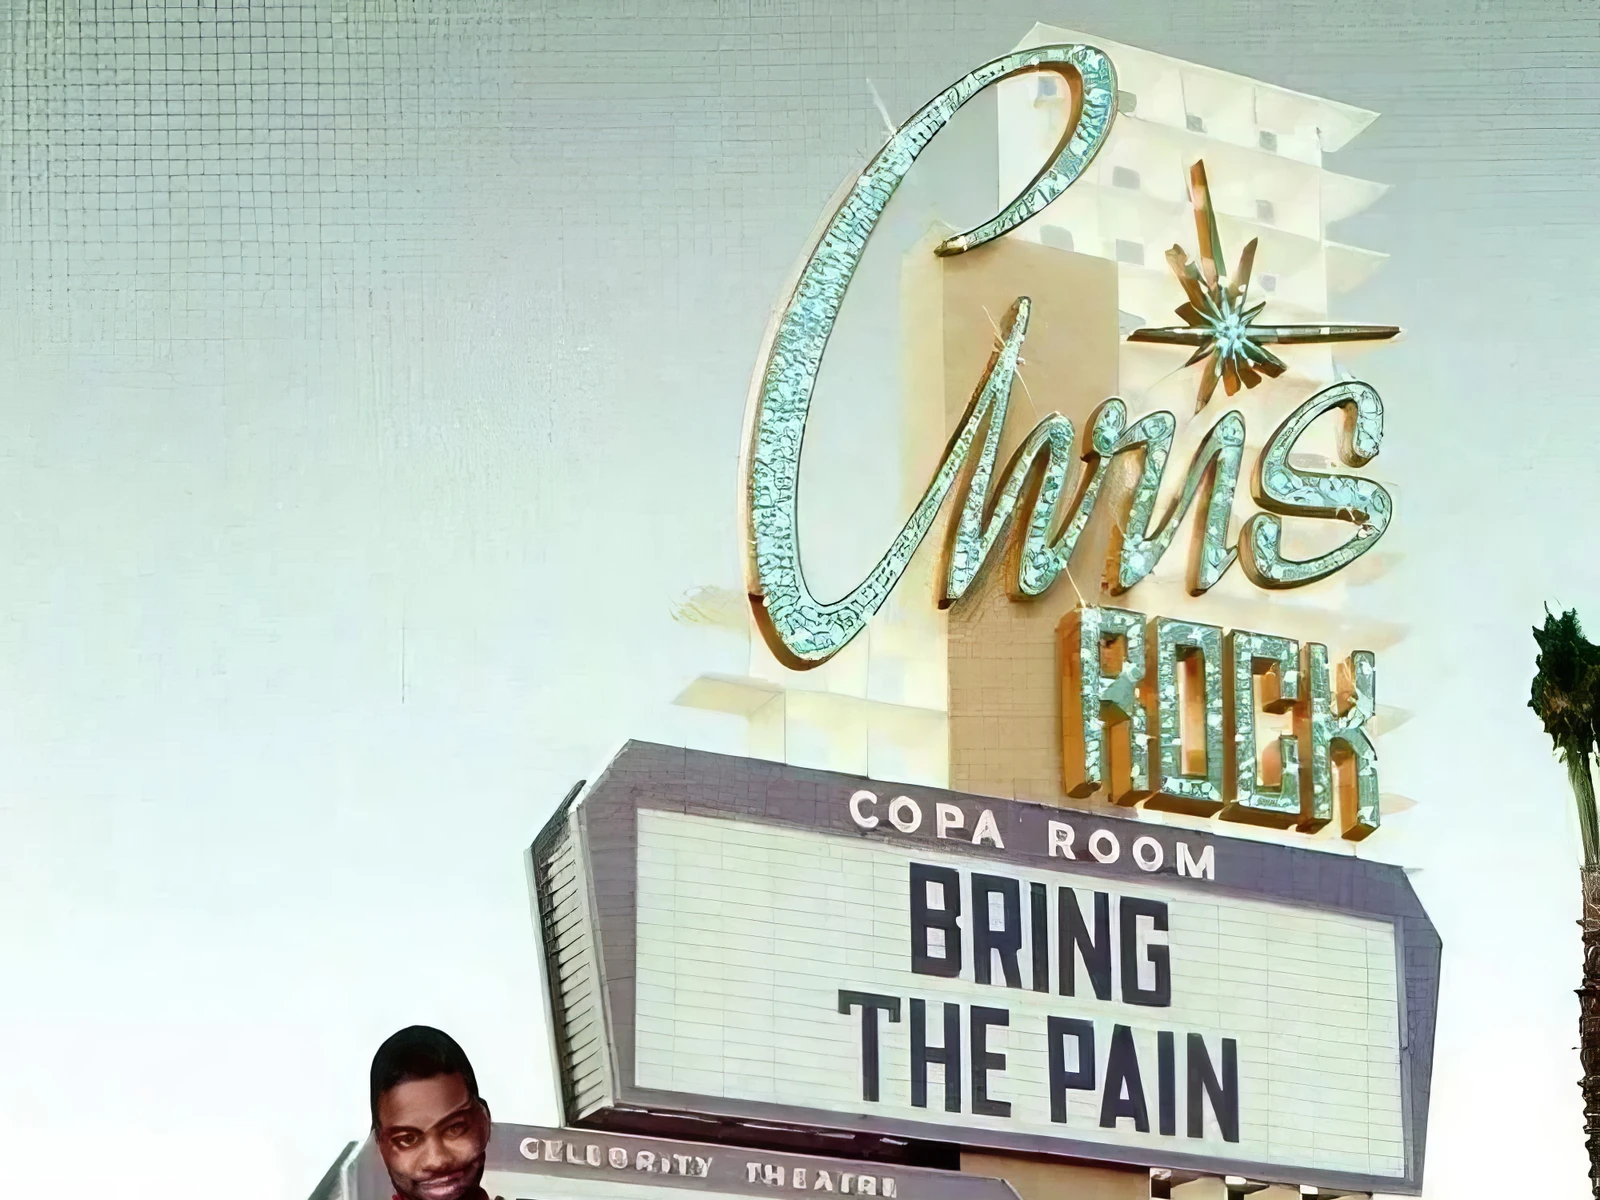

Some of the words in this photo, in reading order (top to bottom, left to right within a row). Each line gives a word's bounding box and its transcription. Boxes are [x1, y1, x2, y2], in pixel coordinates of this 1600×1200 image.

[1058, 604, 1380, 841] ROCK
[848, 789, 1005, 849] COPA
[1048, 819, 1216, 880] ROOM
[909, 861, 1172, 1008] BRING
[838, 989, 1012, 1118] THE
[1047, 1015, 1240, 1143] PAIN
